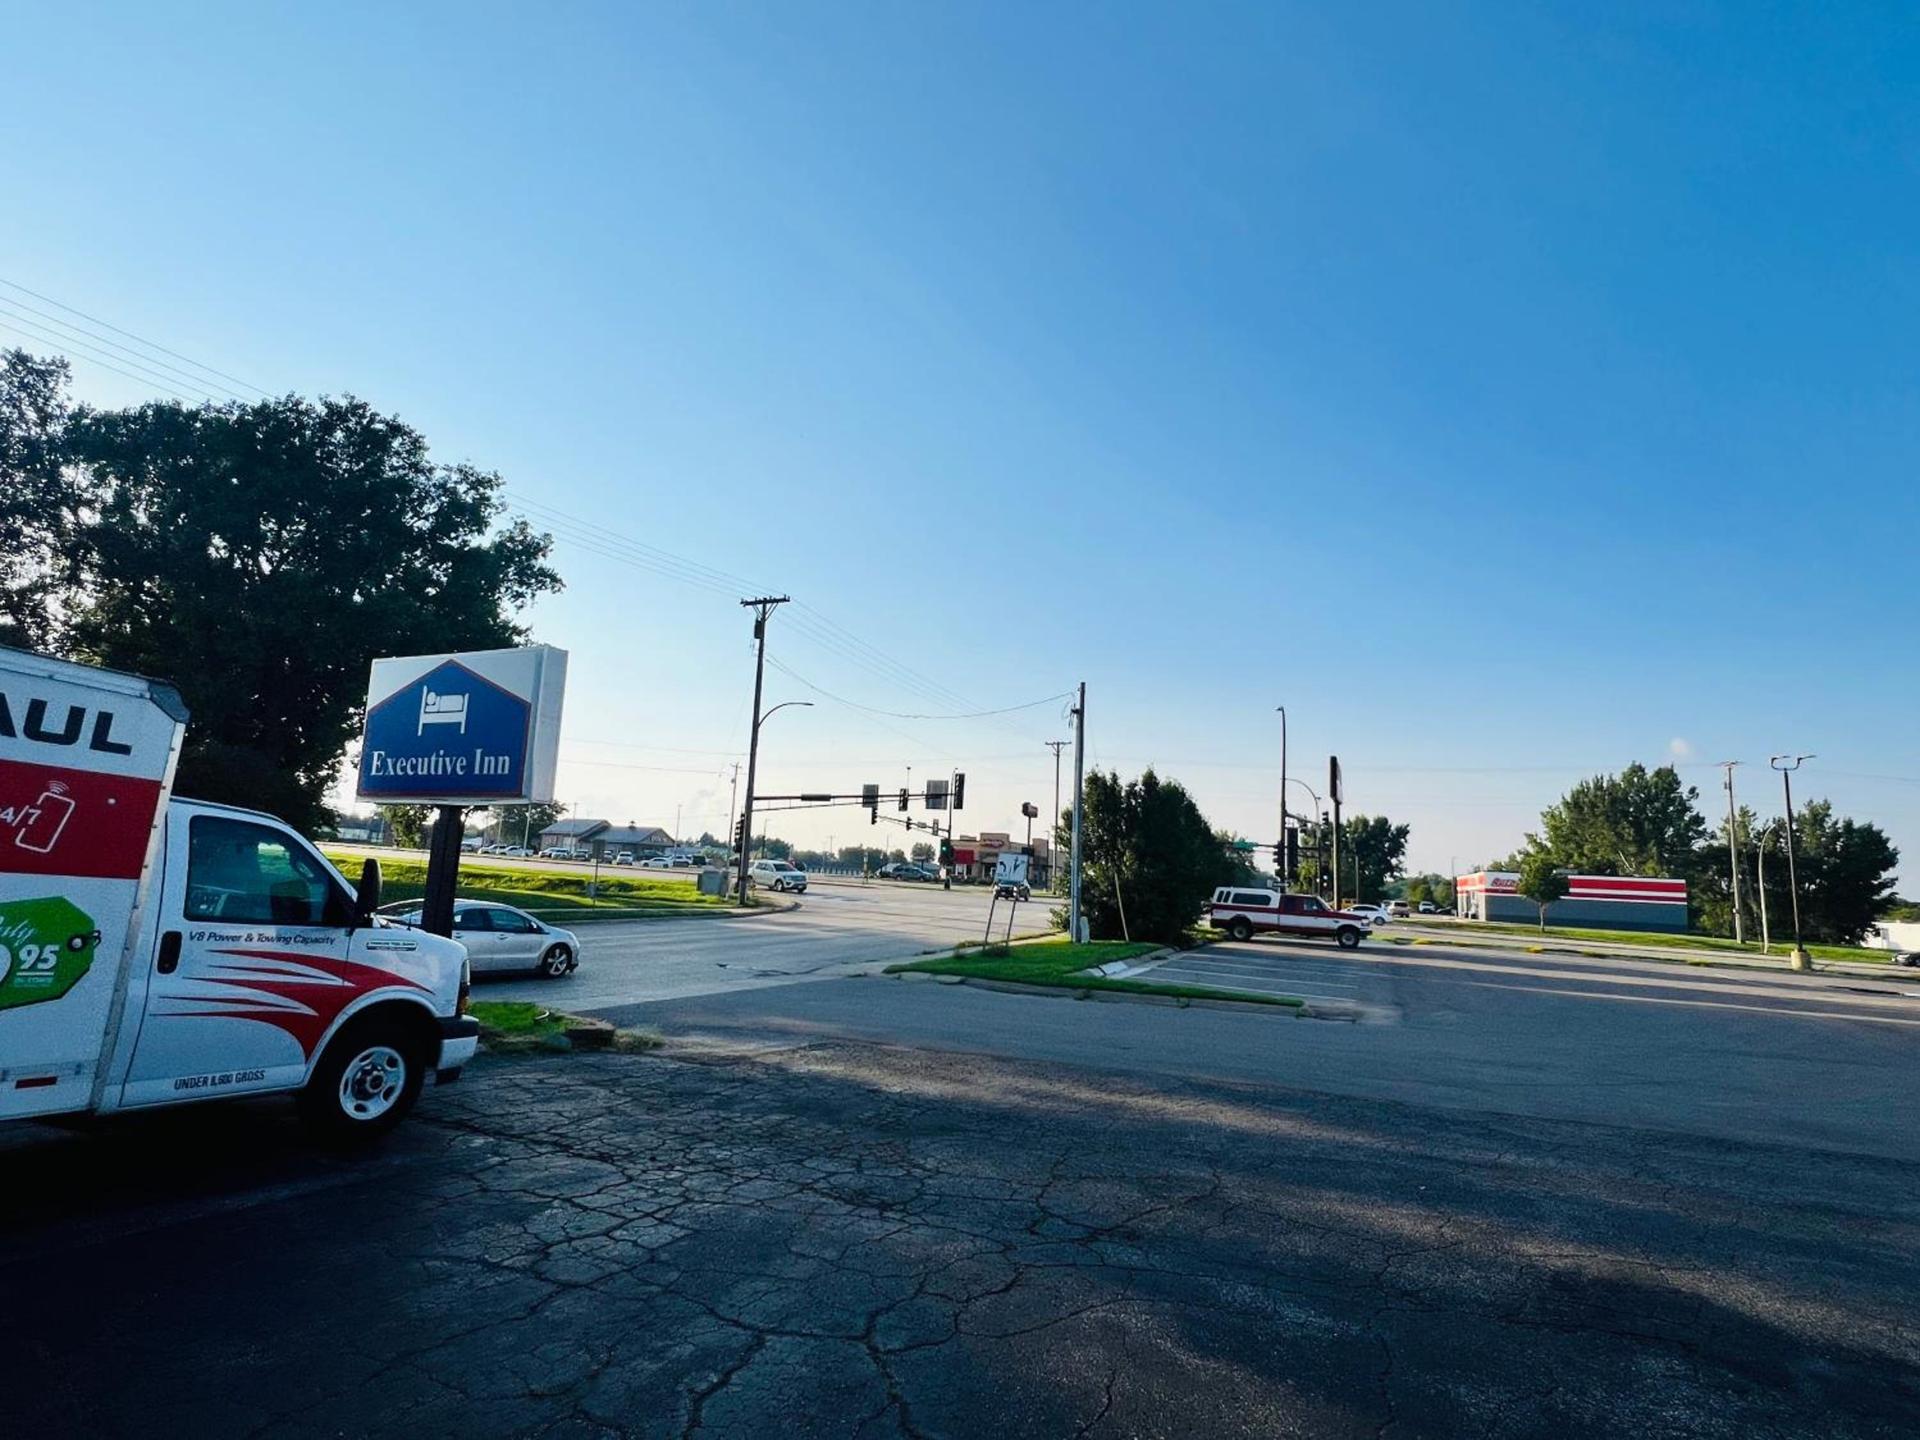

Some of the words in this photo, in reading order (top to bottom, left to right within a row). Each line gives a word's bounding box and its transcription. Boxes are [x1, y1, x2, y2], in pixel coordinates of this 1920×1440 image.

[370, 749, 467, 776] Executive
[474, 748, 510, 775] Inn
[0, 805, 42, 827] 4/7
[188, 931, 206, 942] V8
[207, 931, 243, 943] Power
[244, 932, 255, 943] &
[256, 933, 292, 945] Towing
[293, 934, 336, 946] Capacity
[19, 943, 60, 970] 95
[174, 1076, 209, 1090] UNDER
[235, 1070, 266, 1084] GROSS
